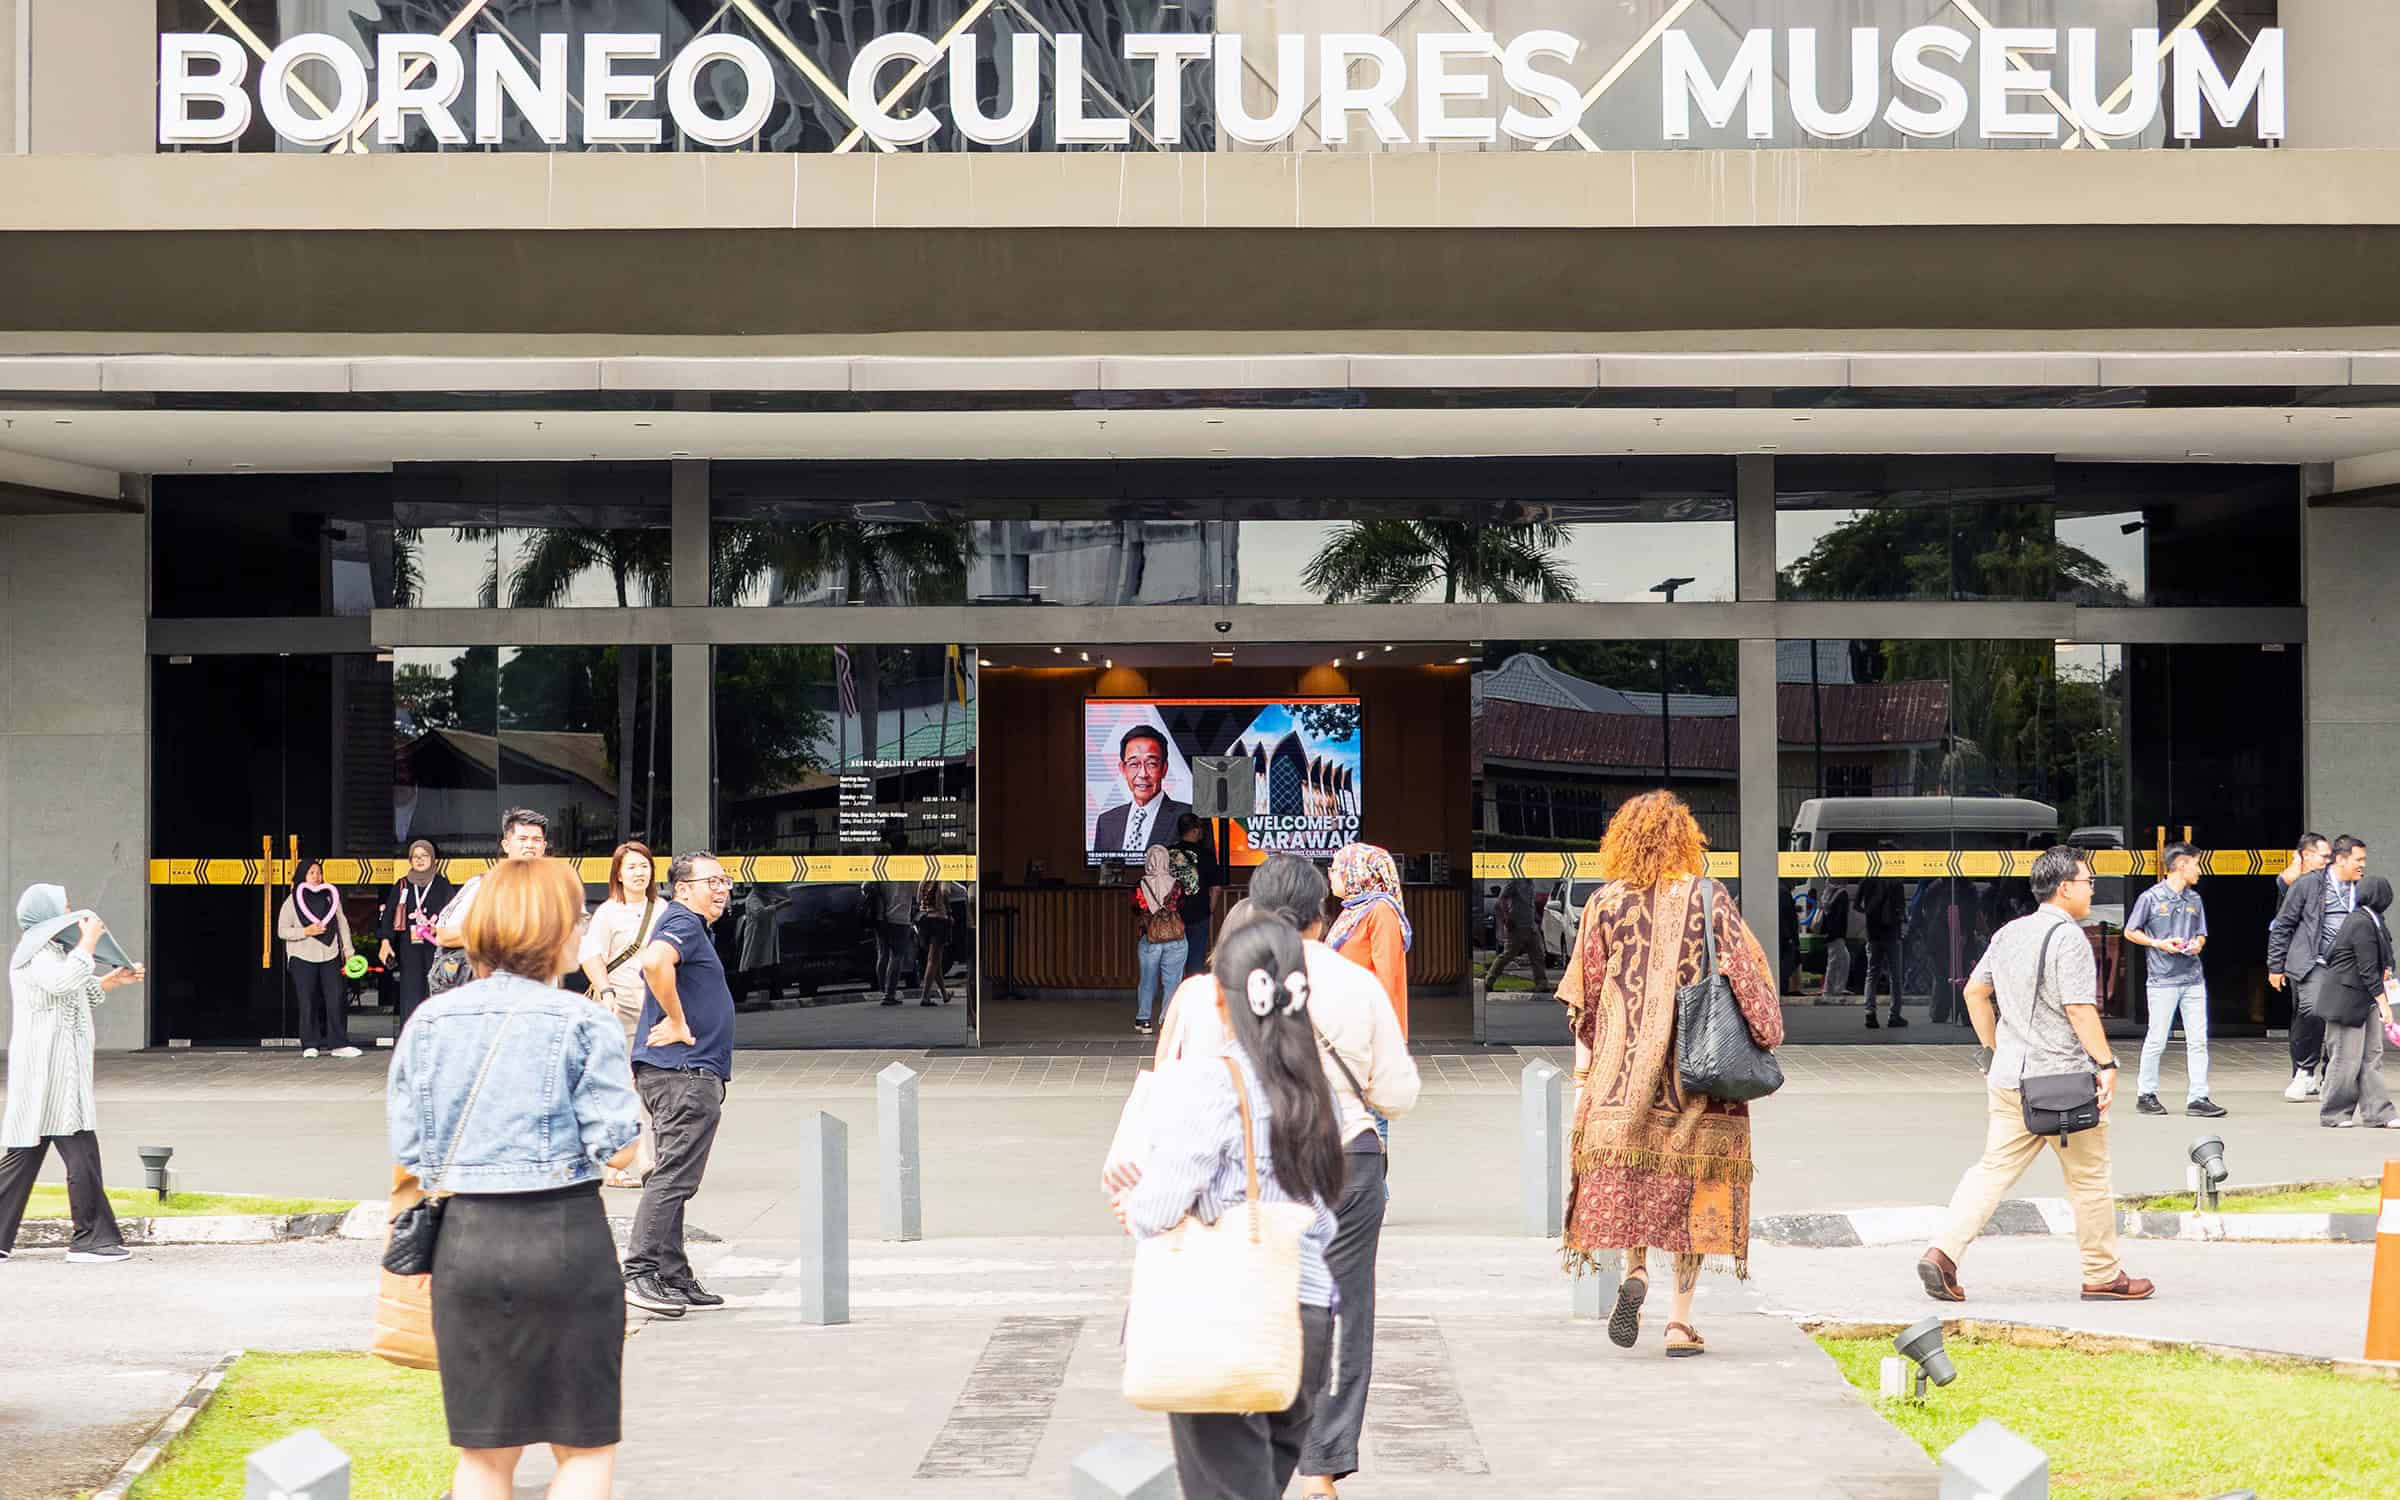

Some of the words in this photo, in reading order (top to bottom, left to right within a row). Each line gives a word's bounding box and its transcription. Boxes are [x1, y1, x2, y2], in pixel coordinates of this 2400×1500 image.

[159, 33, 776, 146] BORNEO
[847, 29, 1583, 145] CULTURES
[1661, 25, 2285, 140] MUSEUM
[1247, 815, 1333, 830] WELCOME
[1336, 815, 1360, 830] TO
[1247, 831, 1360, 850] SARAWAK
